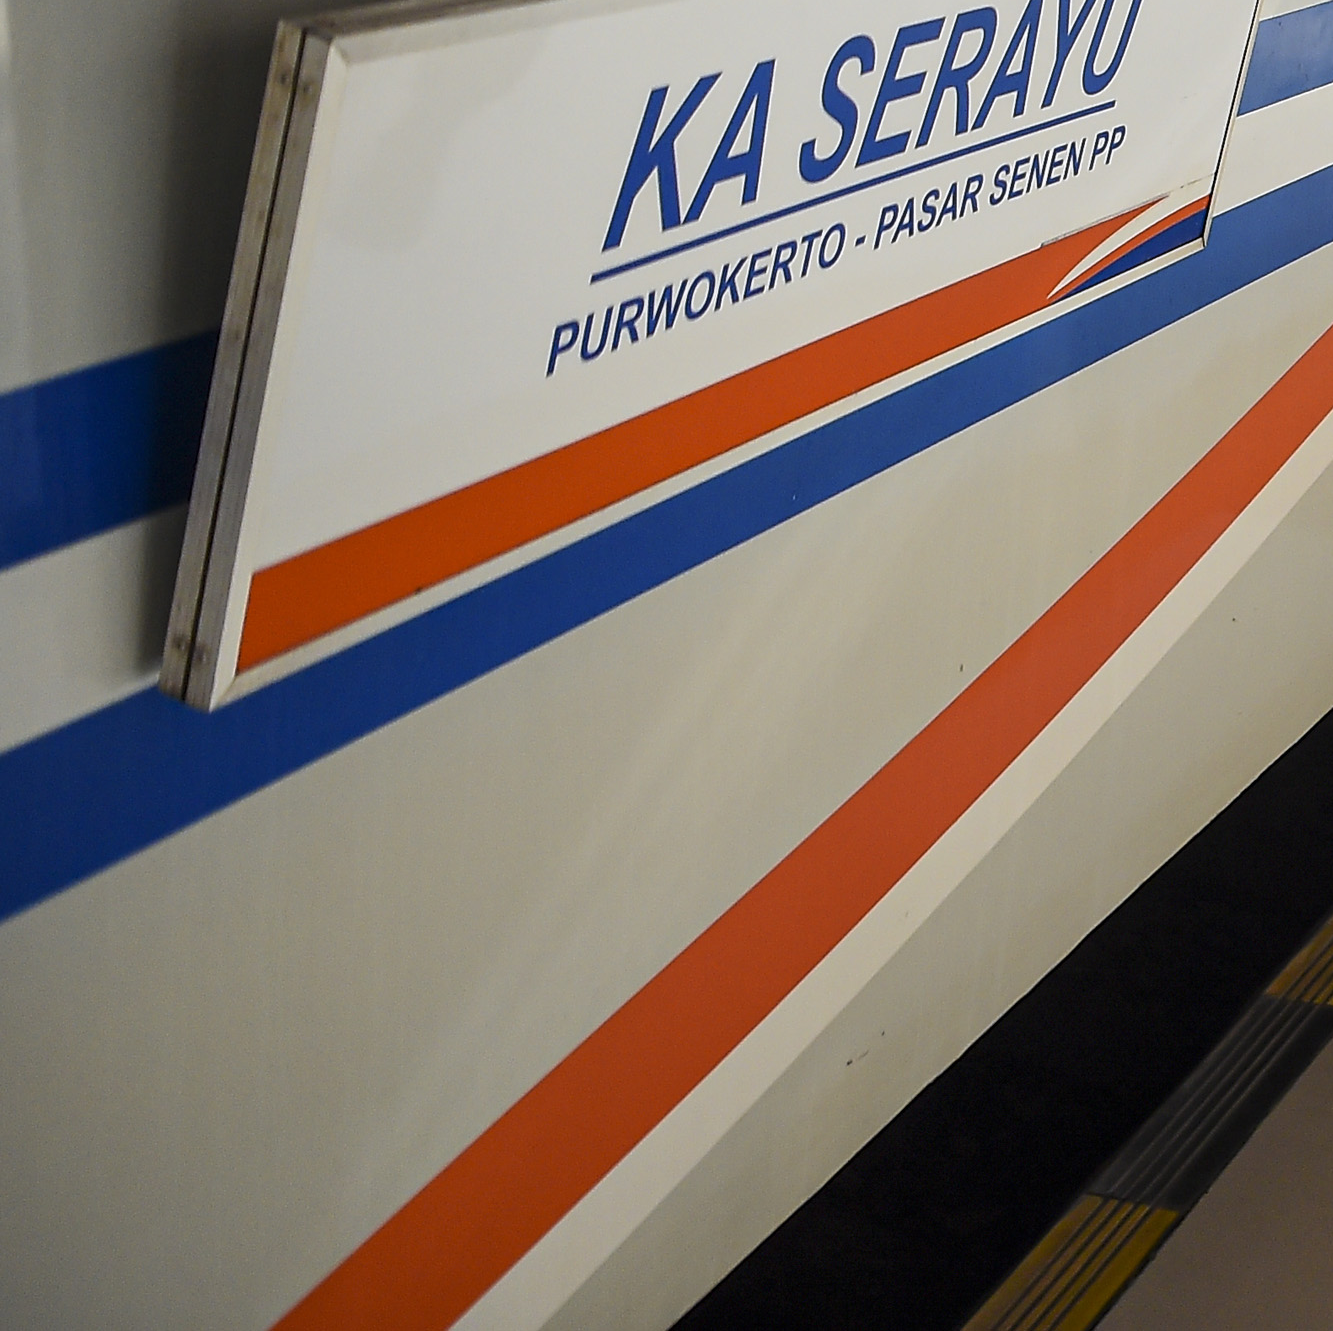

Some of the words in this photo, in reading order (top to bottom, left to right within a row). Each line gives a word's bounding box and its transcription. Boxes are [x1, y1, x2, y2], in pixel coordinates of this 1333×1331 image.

[545, 221, 847, 378] PURWOKERTO
[874, 169, 981, 251] PASAR
[989, 133, 1083, 206] SENEN
[1089, 125, 1127, 172] PP
[600, 57, 777, 254] KA
